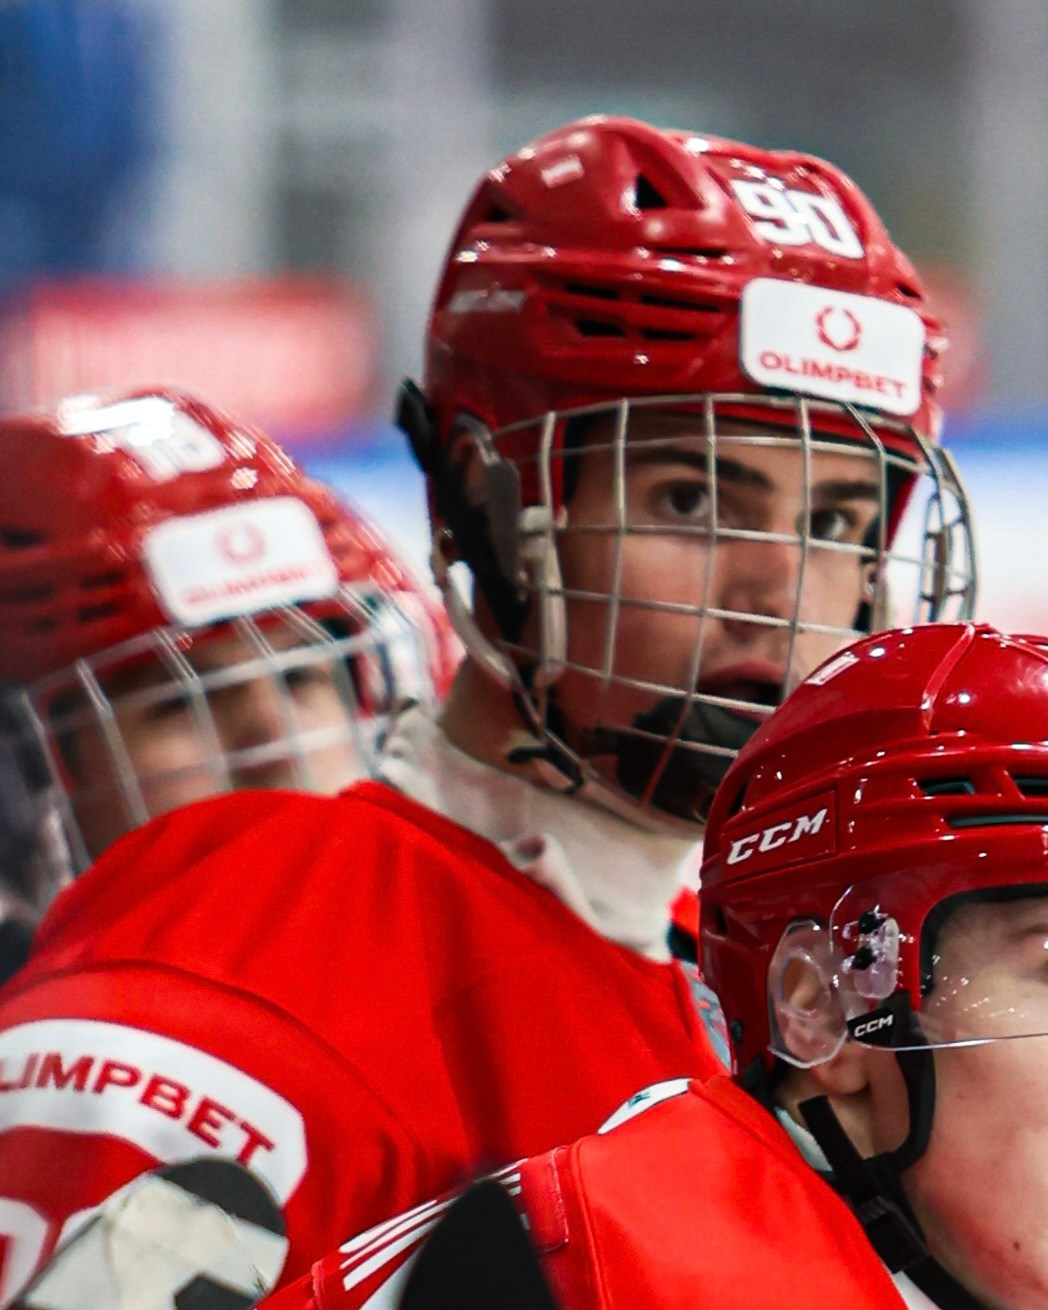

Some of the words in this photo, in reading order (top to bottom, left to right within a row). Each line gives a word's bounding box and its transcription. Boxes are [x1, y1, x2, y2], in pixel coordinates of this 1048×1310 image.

[730, 179, 866, 260] 90
[759, 351, 907, 399] OLIMPBET
[727, 808, 828, 865] CCM
[854, 1014, 894, 1037] CCM
